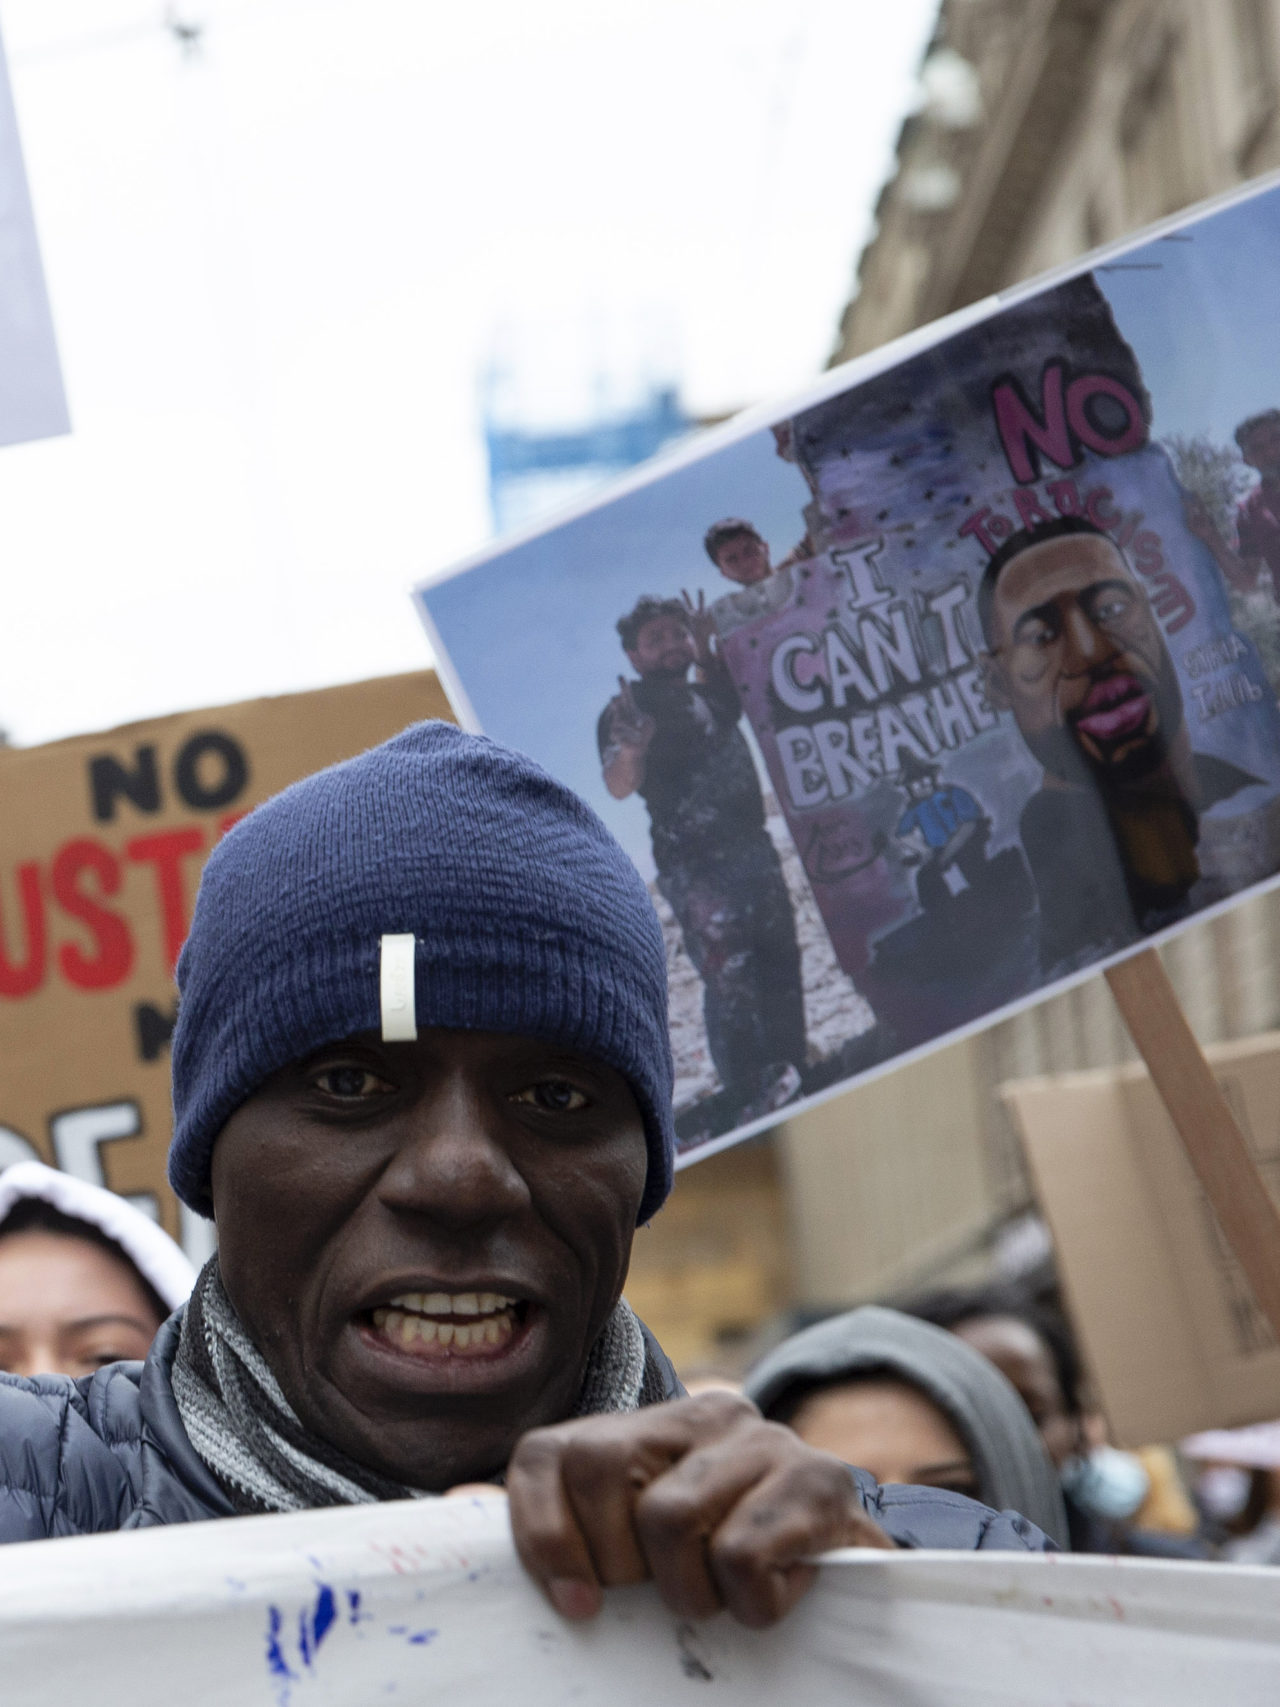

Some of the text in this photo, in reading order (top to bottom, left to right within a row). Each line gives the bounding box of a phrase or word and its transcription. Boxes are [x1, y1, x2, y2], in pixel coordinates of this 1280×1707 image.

[990, 358, 1147, 485] NO
[830, 543, 894, 610] I
[89, 728, 250, 825] NO
[776, 670, 996, 806] BREATHE
